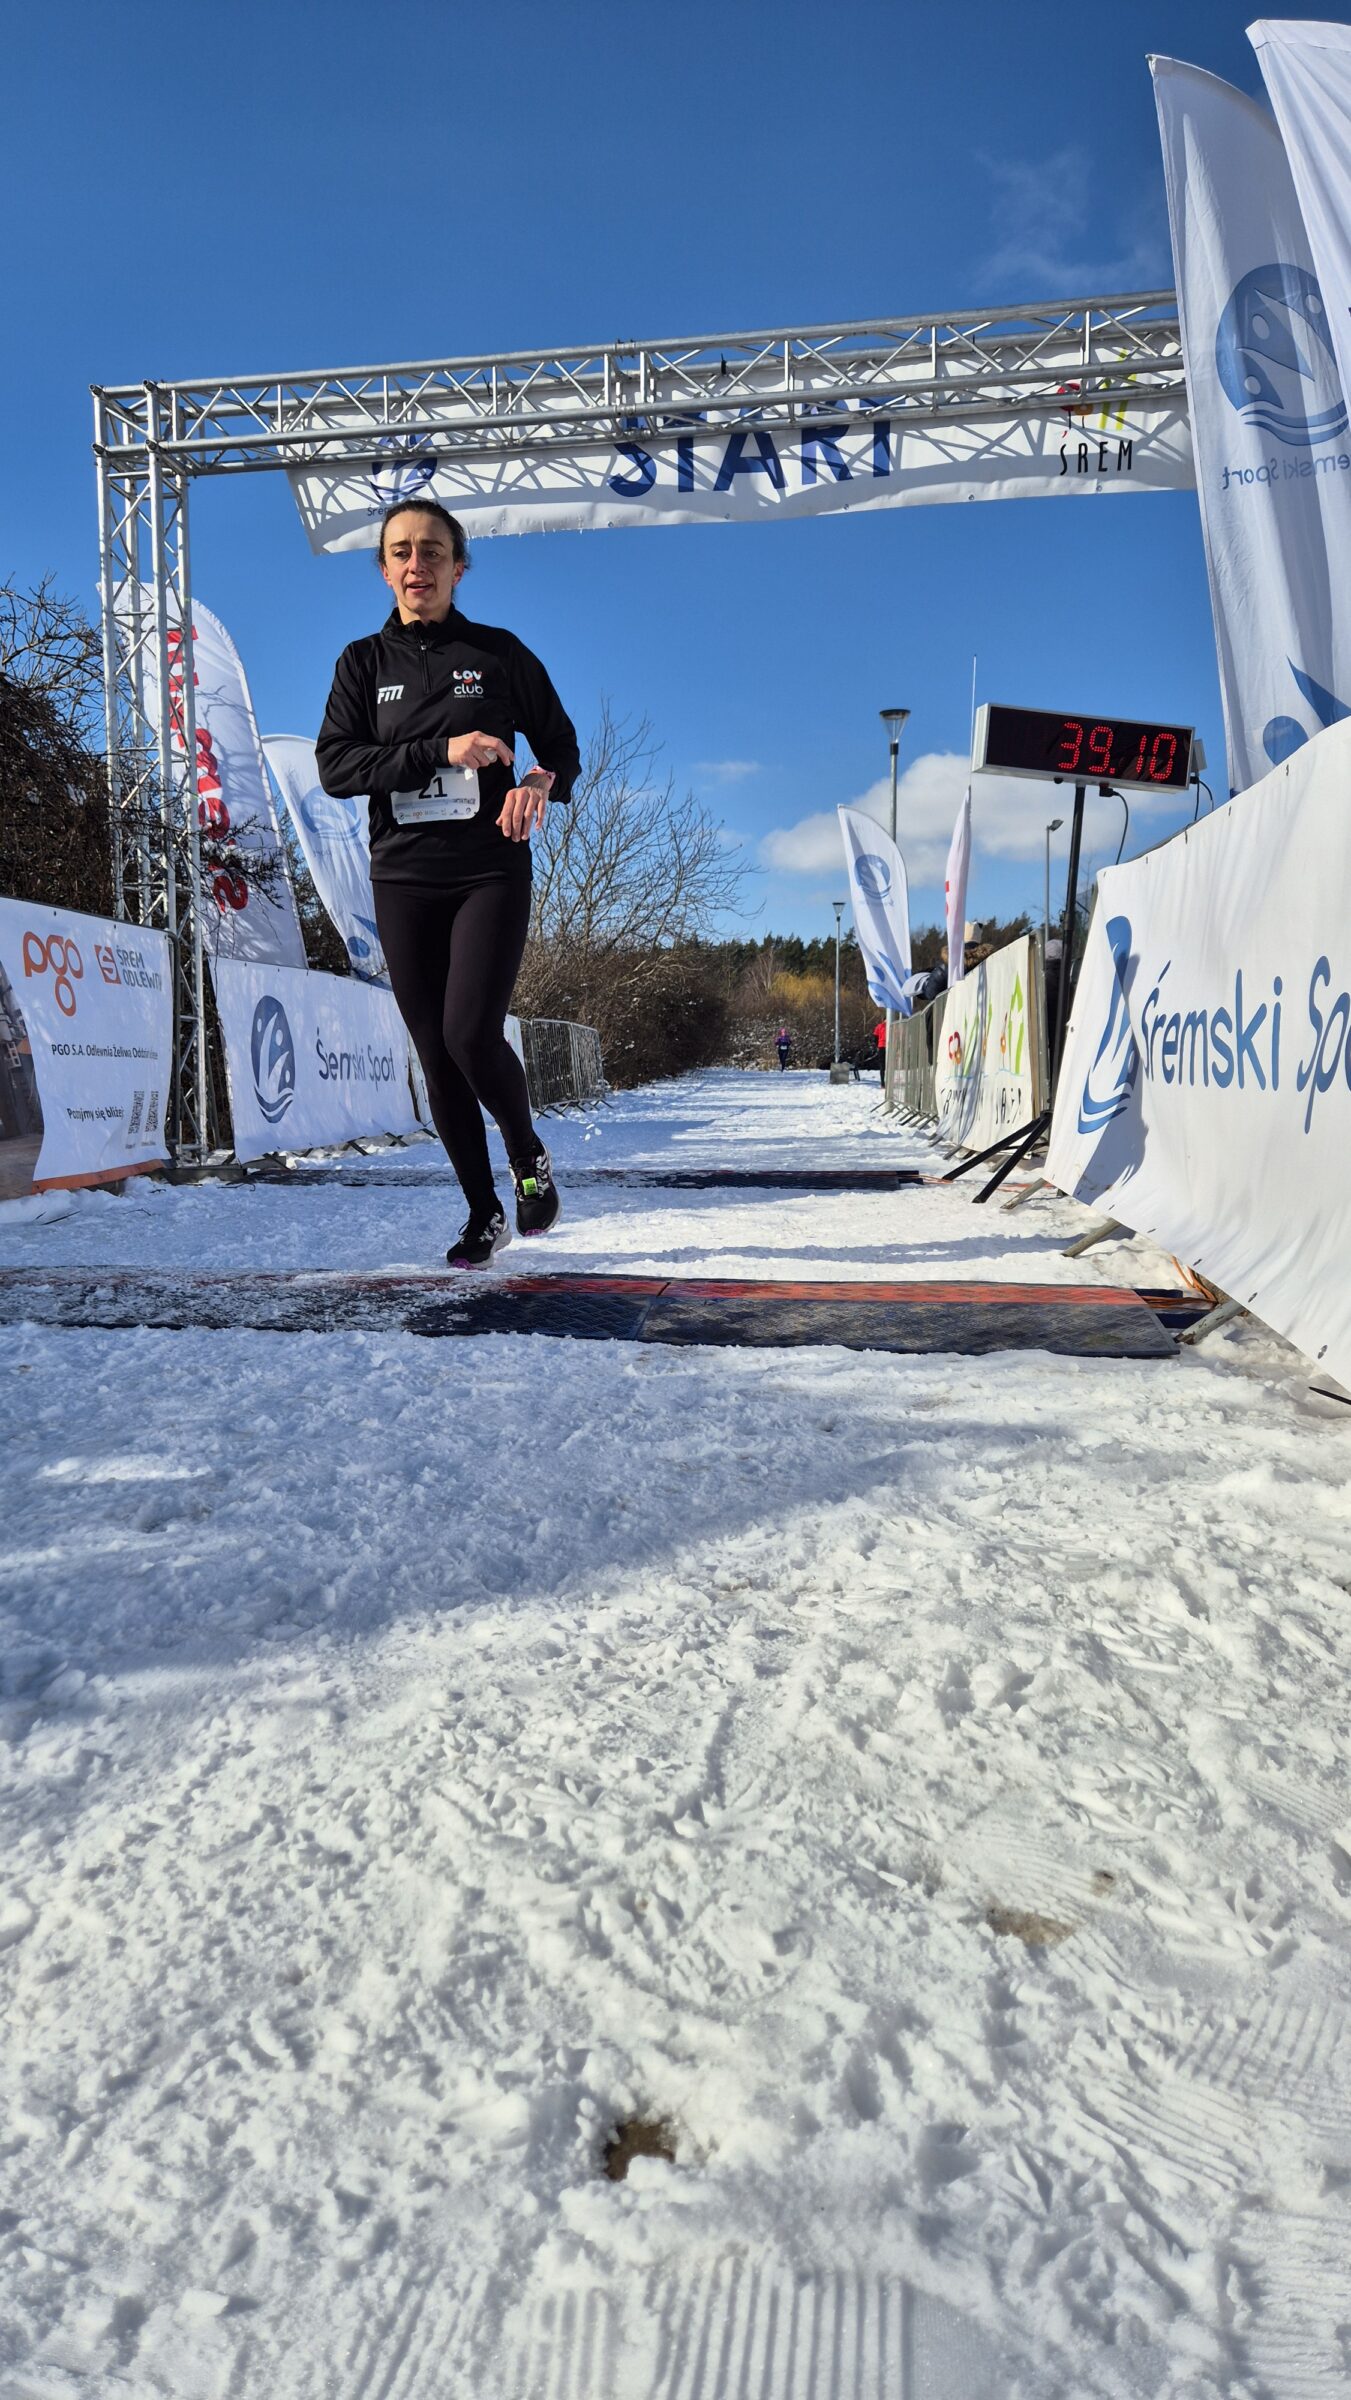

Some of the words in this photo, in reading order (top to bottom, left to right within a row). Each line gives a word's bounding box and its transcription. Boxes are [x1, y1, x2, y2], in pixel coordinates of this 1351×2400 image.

[606, 393, 906, 497] START
[1059, 430, 1133, 476] ŚREM
[454, 683, 484, 695] club
[52, 1044, 71, 1056] PGO
[1142, 959, 1283, 1091] Śremski
[1297, 955, 1351, 1134] Sp
